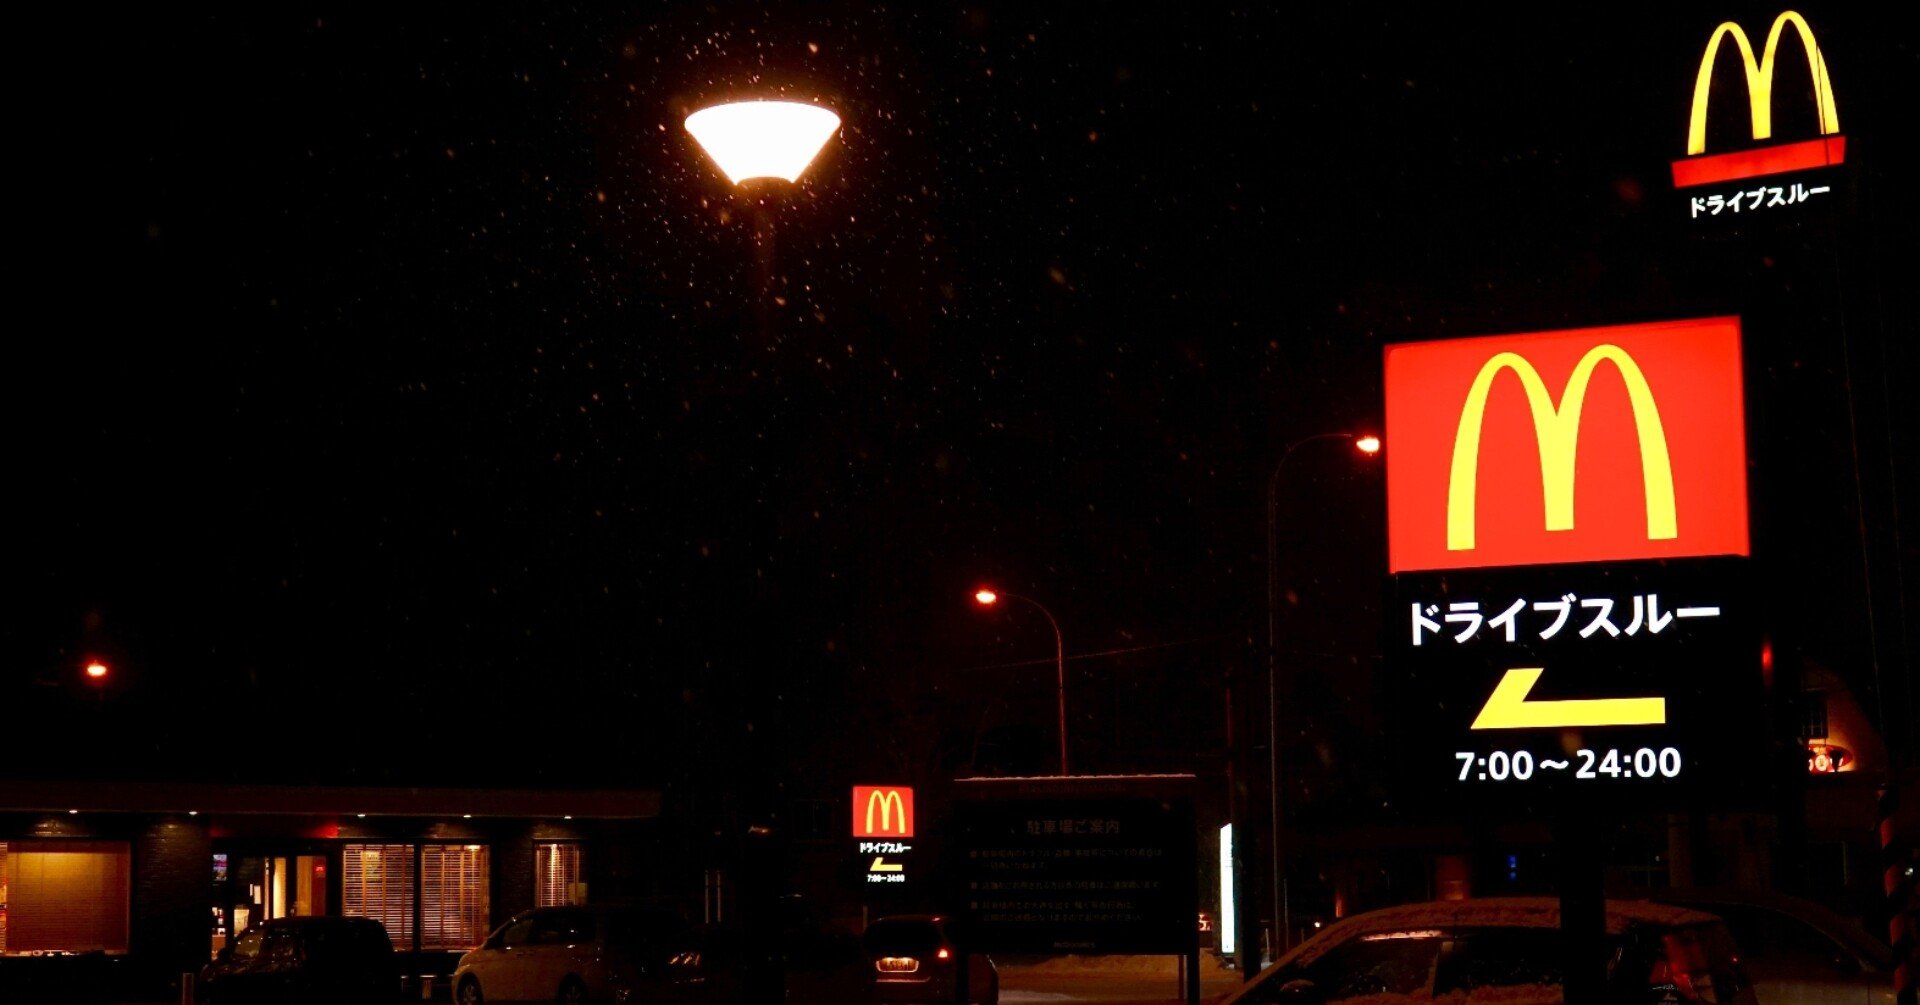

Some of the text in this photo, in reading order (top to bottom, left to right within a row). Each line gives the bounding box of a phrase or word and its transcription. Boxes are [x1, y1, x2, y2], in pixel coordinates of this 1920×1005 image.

[1690, 183, 1831, 219] ドライブスルー
[1411, 593, 1721, 646] ドライブスルー
[859, 841, 912, 854] ドライブスルー
